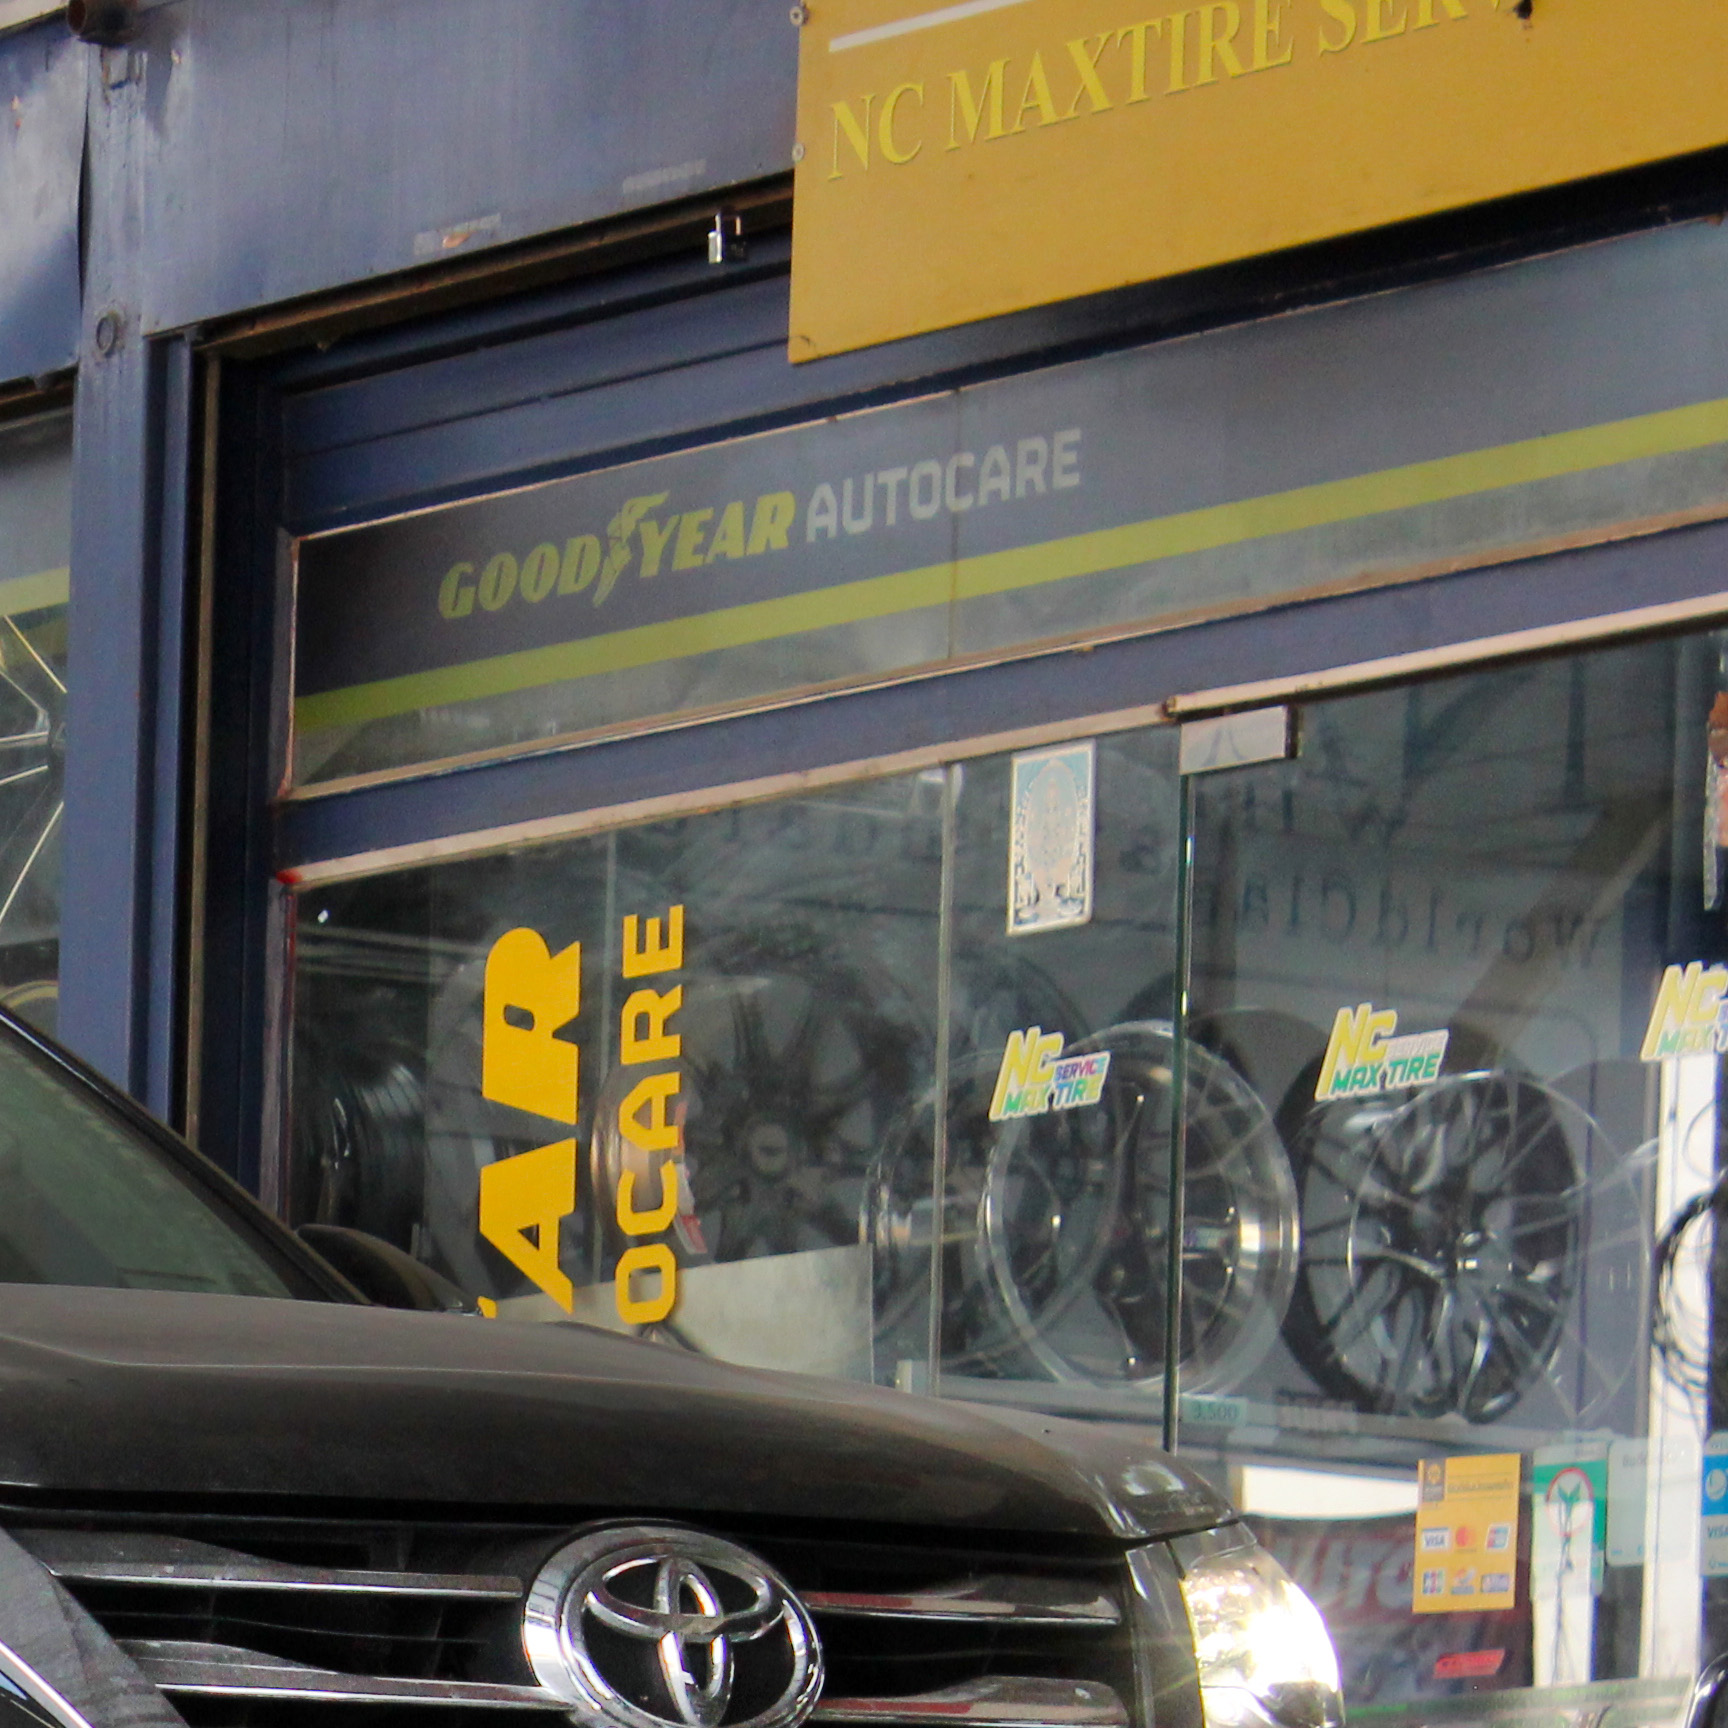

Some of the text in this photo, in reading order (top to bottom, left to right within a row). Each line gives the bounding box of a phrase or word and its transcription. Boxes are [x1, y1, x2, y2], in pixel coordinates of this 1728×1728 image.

[826, 81, 925, 181] NC
[945, 2, 1294, 152] MAXTIRE
[439, 429, 1083, 618] GOODYEAR AUTOCARE
[989, 1027, 1063, 1119] NC
[1054, 1056, 1108, 1081] SERVICE
[1315, 1003, 1397, 1099] NC
[1330, 1053, 1440, 1095] MAX TIRE
[1003, 1075, 1103, 1115] MAX TIRE
[1424, 1535, 1446, 1548] VISA
